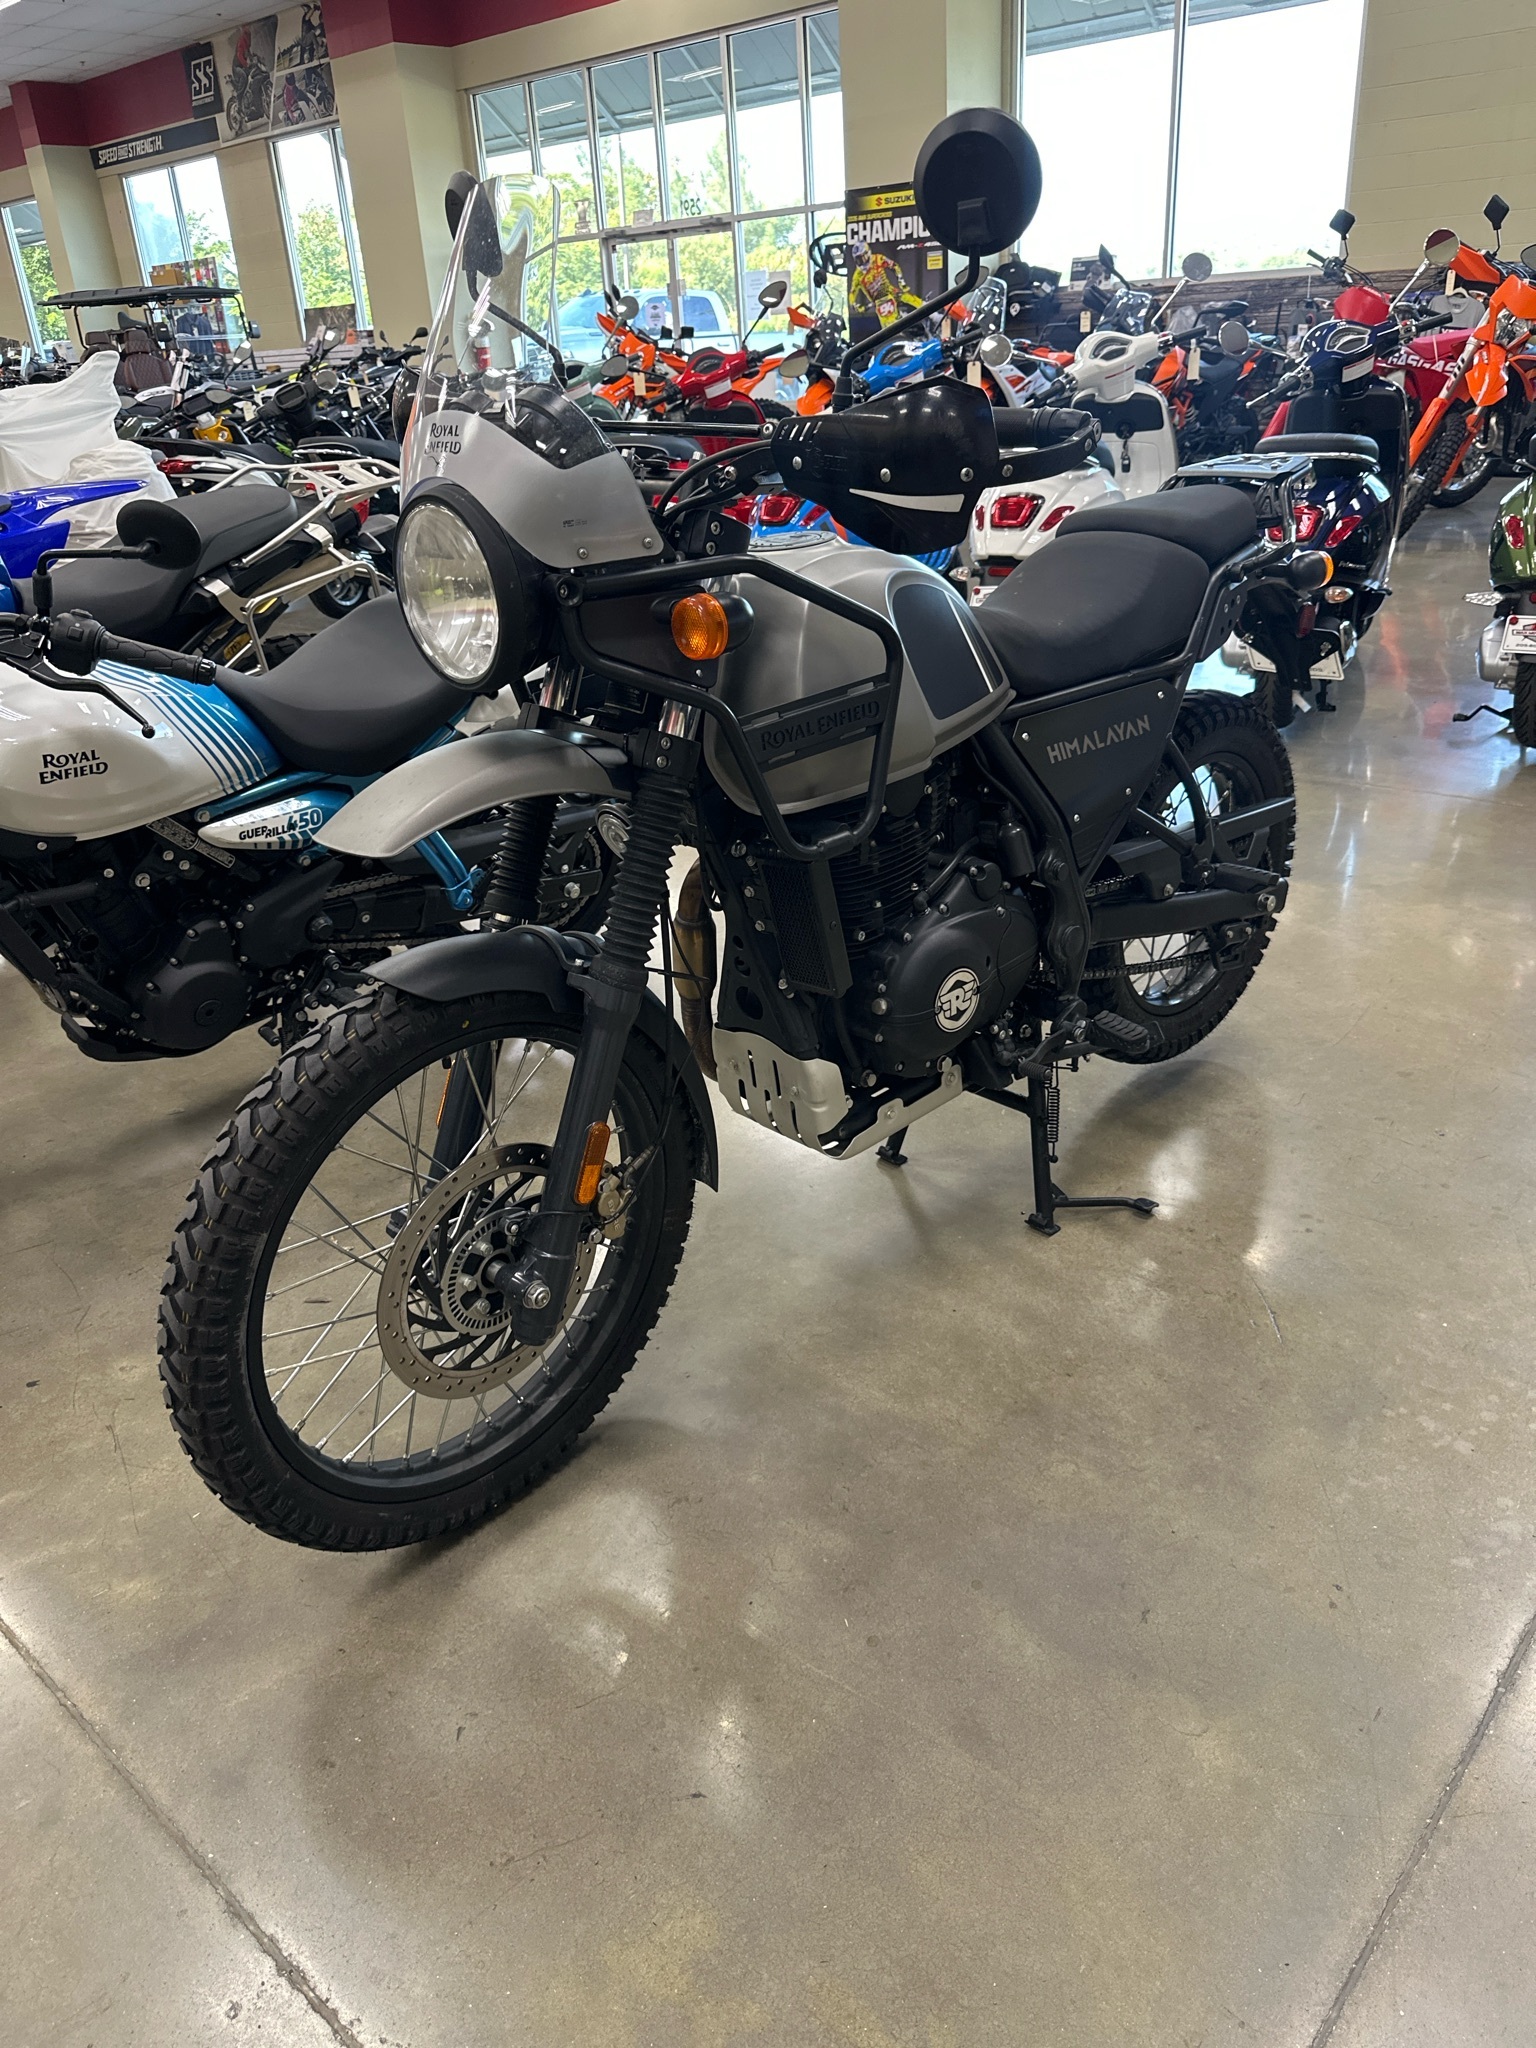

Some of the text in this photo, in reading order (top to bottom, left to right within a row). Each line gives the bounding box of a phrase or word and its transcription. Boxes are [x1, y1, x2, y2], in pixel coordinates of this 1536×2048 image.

[98, 147, 117, 165] SPEED
[128, 135, 163, 157] STRENGTH
[847, 215, 931, 245] CHAMPIO
[430, 422, 460, 438] ROYAL
[760, 700, 880, 751] ROYAL ENFIELD
[1046, 714, 1151, 764] HIMALAYAN
[39, 762, 108, 784] ENFIELD
[42, 749, 101, 768] ROYAL
[238, 809, 321, 840] GUERRILLA 450
